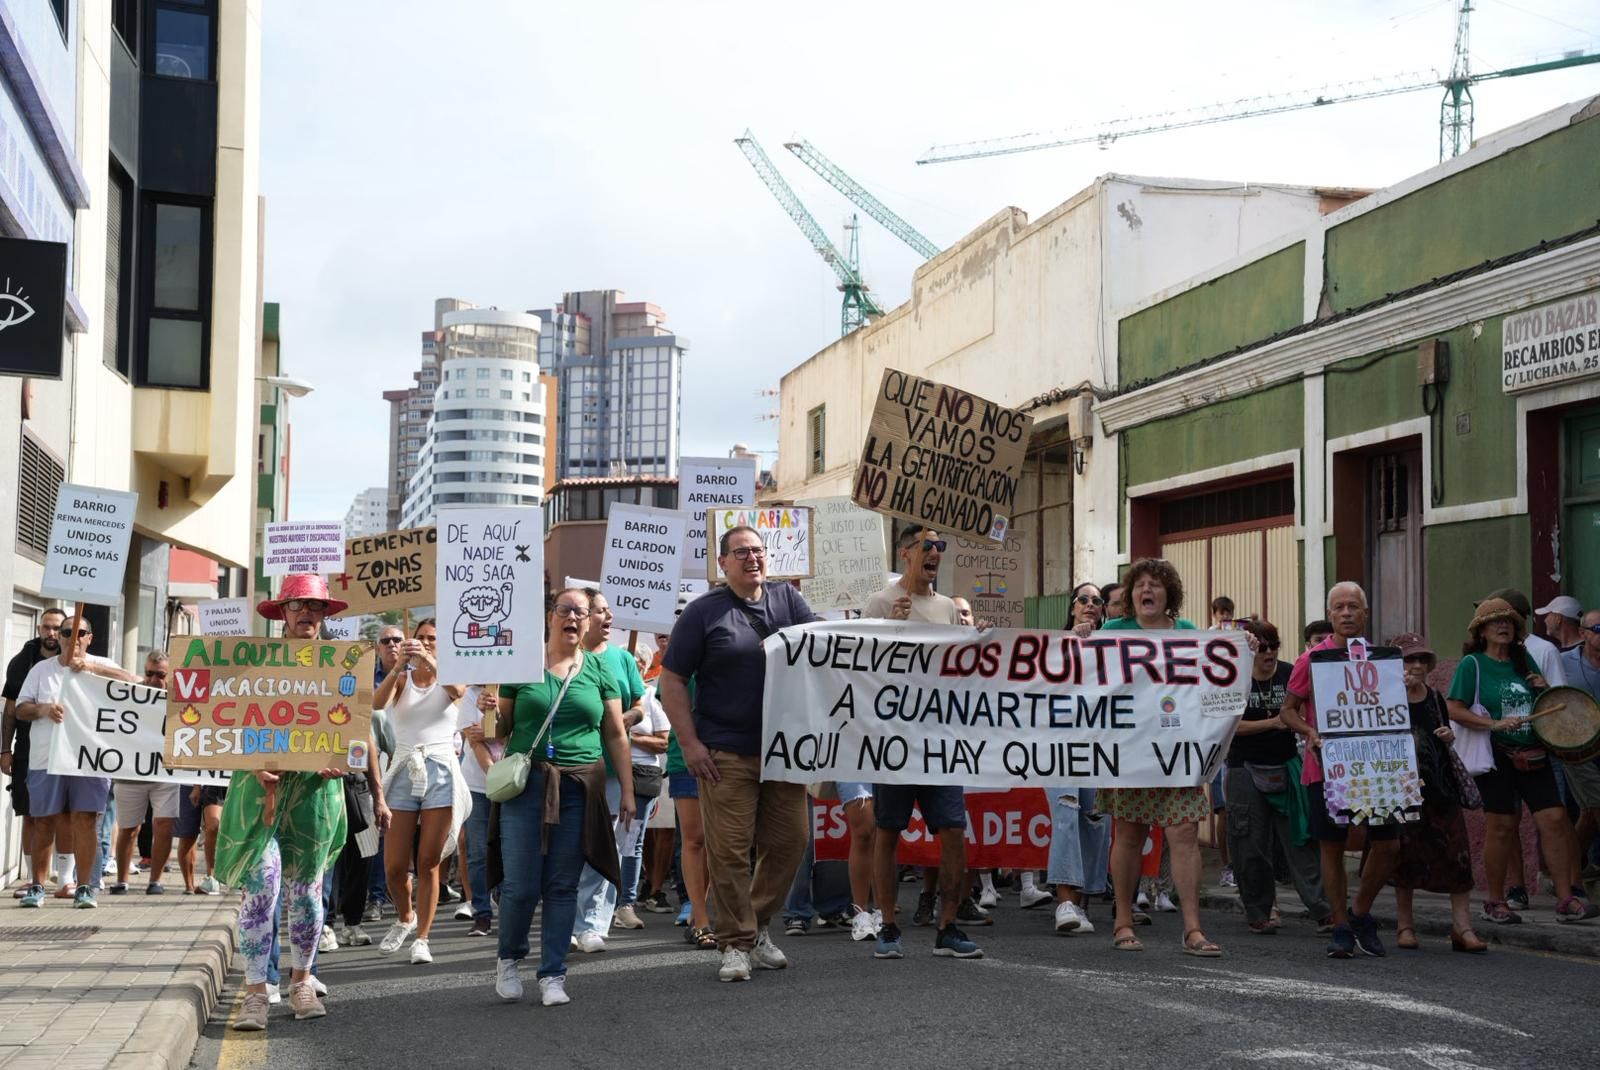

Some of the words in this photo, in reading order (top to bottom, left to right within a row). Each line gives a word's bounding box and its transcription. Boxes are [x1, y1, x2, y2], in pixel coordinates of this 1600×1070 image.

[1504, 310, 1542, 346] AUTO
[1545, 295, 1597, 335] BAZAR
[1504, 333, 1584, 371] RECAMBIOS
[1519, 360, 1580, 383] LUCHANA,
[1584, 355, 1598, 369] 25
[884, 370, 934, 413] QUE
[935, 386, 974, 425] NO
[980, 404, 1025, 443] NOS
[904, 408, 996, 464] VAMOS
[865, 436, 892, 470] LA
[696, 474, 737, 485] BARRIO
[73, 499, 116, 514] BARRIO
[688, 493, 743, 504] ARENALES
[855, 465, 887, 508] NO
[890, 476, 916, 515] HA
[920, 487, 992, 536] GANADO
[56, 513, 82, 523] REINA
[84, 518, 126, 530] MERCEDES
[447, 523, 469, 543] DE
[483, 519, 521, 542] AQUÍ
[624, 520, 668, 535] BARRIO
[827, 519, 855, 534] JUSTO
[860, 518, 877, 531] LOS
[67, 529, 112, 544] UNIDOS
[352, 528, 437, 556] CEMENTO
[611, 538, 624, 548] EL
[627, 540, 676, 555] CARDON
[822, 540, 844, 555] QUE
[853, 536, 868, 552] TE
[53, 545, 93, 558] SOMOS
[95, 551, 119, 562] MÁS
[463, 546, 505, 561] NADIE
[63, 563, 97, 578] LPGC
[356, 553, 422, 581] ZONAS
[445, 564, 474, 583] NOS
[482, 563, 515, 582] SACA
[619, 558, 664, 573] UNIDOS
[839, 557, 882, 574] PERMITIR
[365, 575, 422, 599] VERDES
[606, 575, 645, 588] SOMOS
[648, 579, 672, 592] MÁS
[211, 606, 241, 615] PALMAS
[616, 595, 650, 610] LPGC
[209, 618, 239, 627] UNIDOS
[778, 629, 939, 675] VUELVEN
[939, 639, 1002, 678] LOS
[1007, 634, 1240, 687] BUITRES
[1344, 661, 1379, 692] NO
[829, 683, 855, 719] A
[873, 684, 1136, 729] GUANARTEME
[1337, 691, 1348, 706] A
[1354, 691, 1380, 706] LOS
[95, 707, 139, 735] ES
[212, 700, 321, 726] CAOS
[1326, 704, 1408, 729] BUITRES
[172, 727, 348, 757] RESIDENCIAL
[764, 720, 848, 772] AQUÍ
[857, 734, 909, 772] NO
[923, 738, 987, 775] HAY
[1002, 741, 1120, 781] QUIEN
[1325, 739, 1409, 762] GUANARTEME
[77, 745, 123, 773] NO
[1328, 763, 1345, 780] NO
[1349, 761, 1365, 777] SE
[1370, 760, 1409, 773] VENDE
